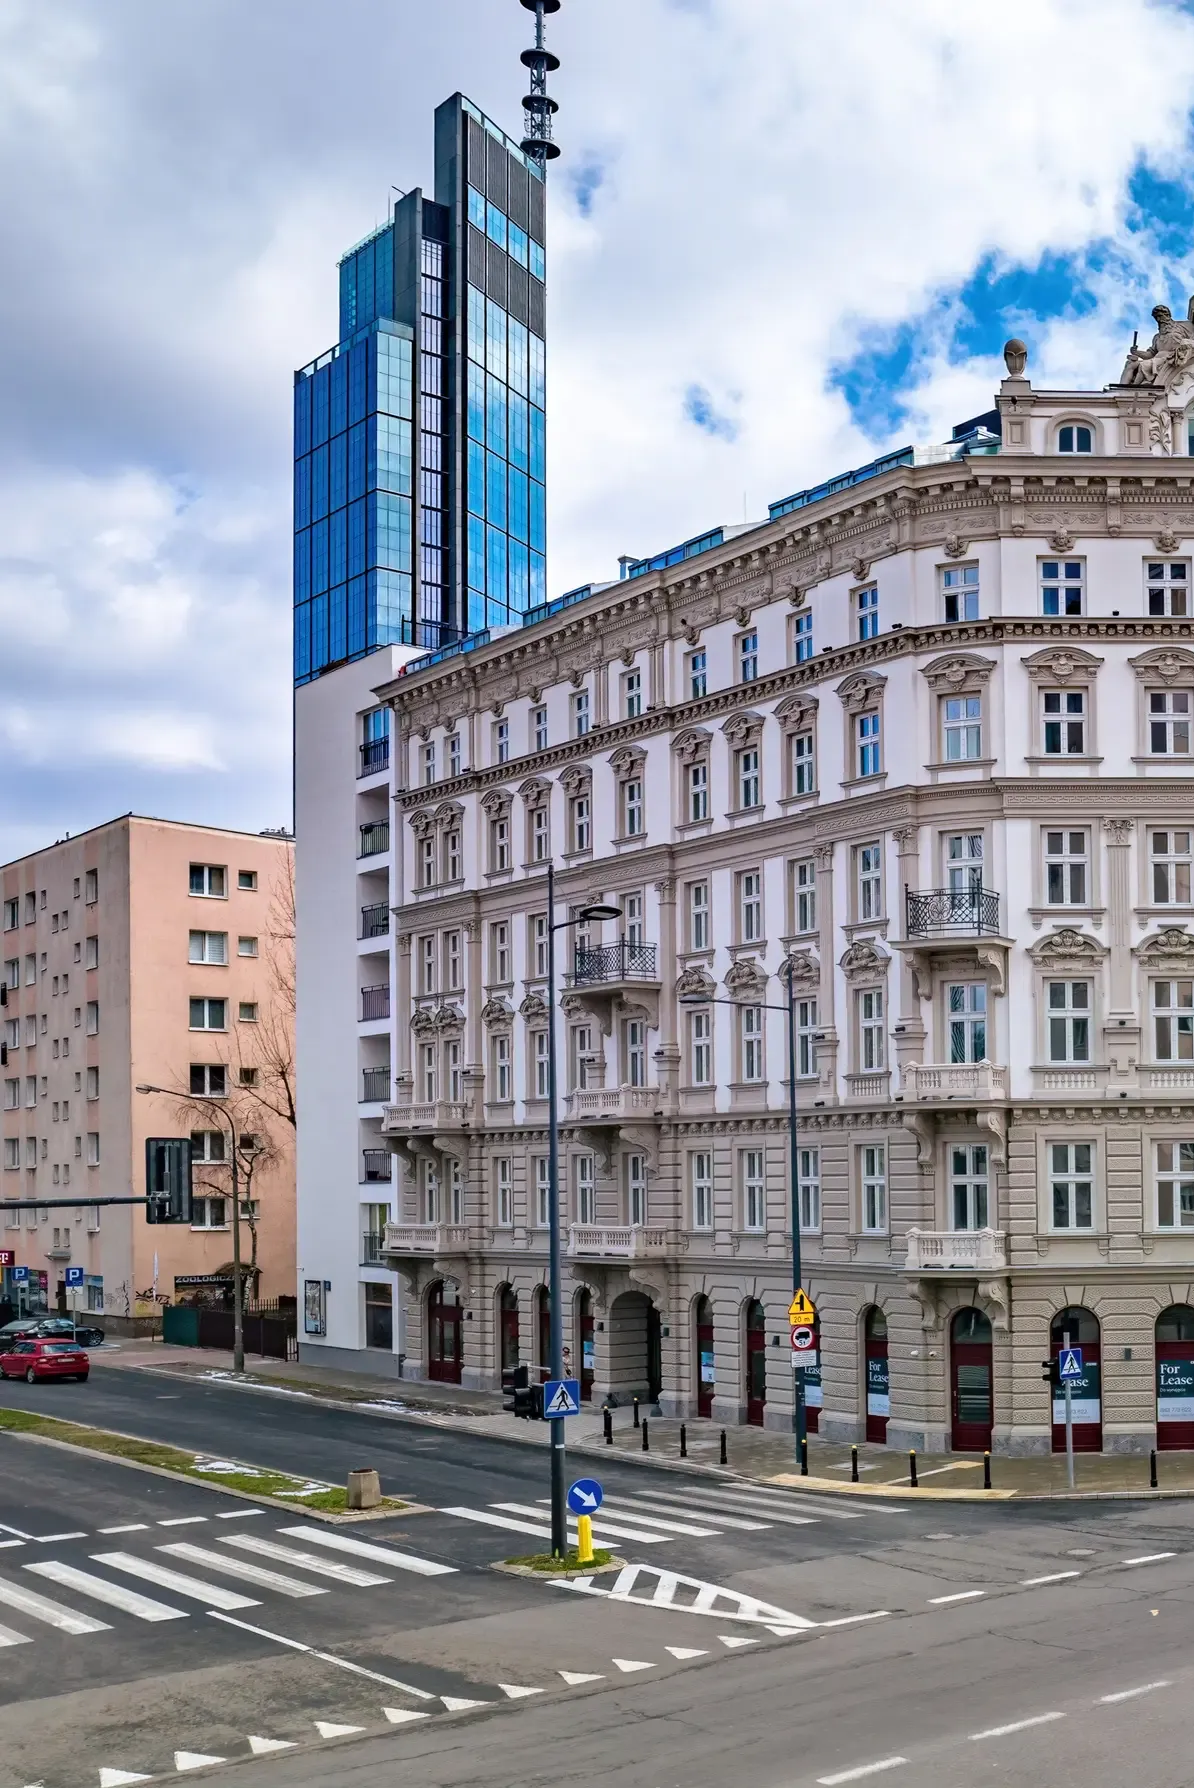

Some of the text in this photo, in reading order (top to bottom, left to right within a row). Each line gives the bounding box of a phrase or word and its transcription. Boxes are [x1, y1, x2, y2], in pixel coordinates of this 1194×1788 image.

[15, 1268, 25, 1280] P
[69, 1269, 80, 1281] P
[869, 1361, 881, 1371] For
[1160, 1364, 1181, 1374] For
[869, 1372, 889, 1383] Lease
[1160, 1375, 1194, 1385] Lease
